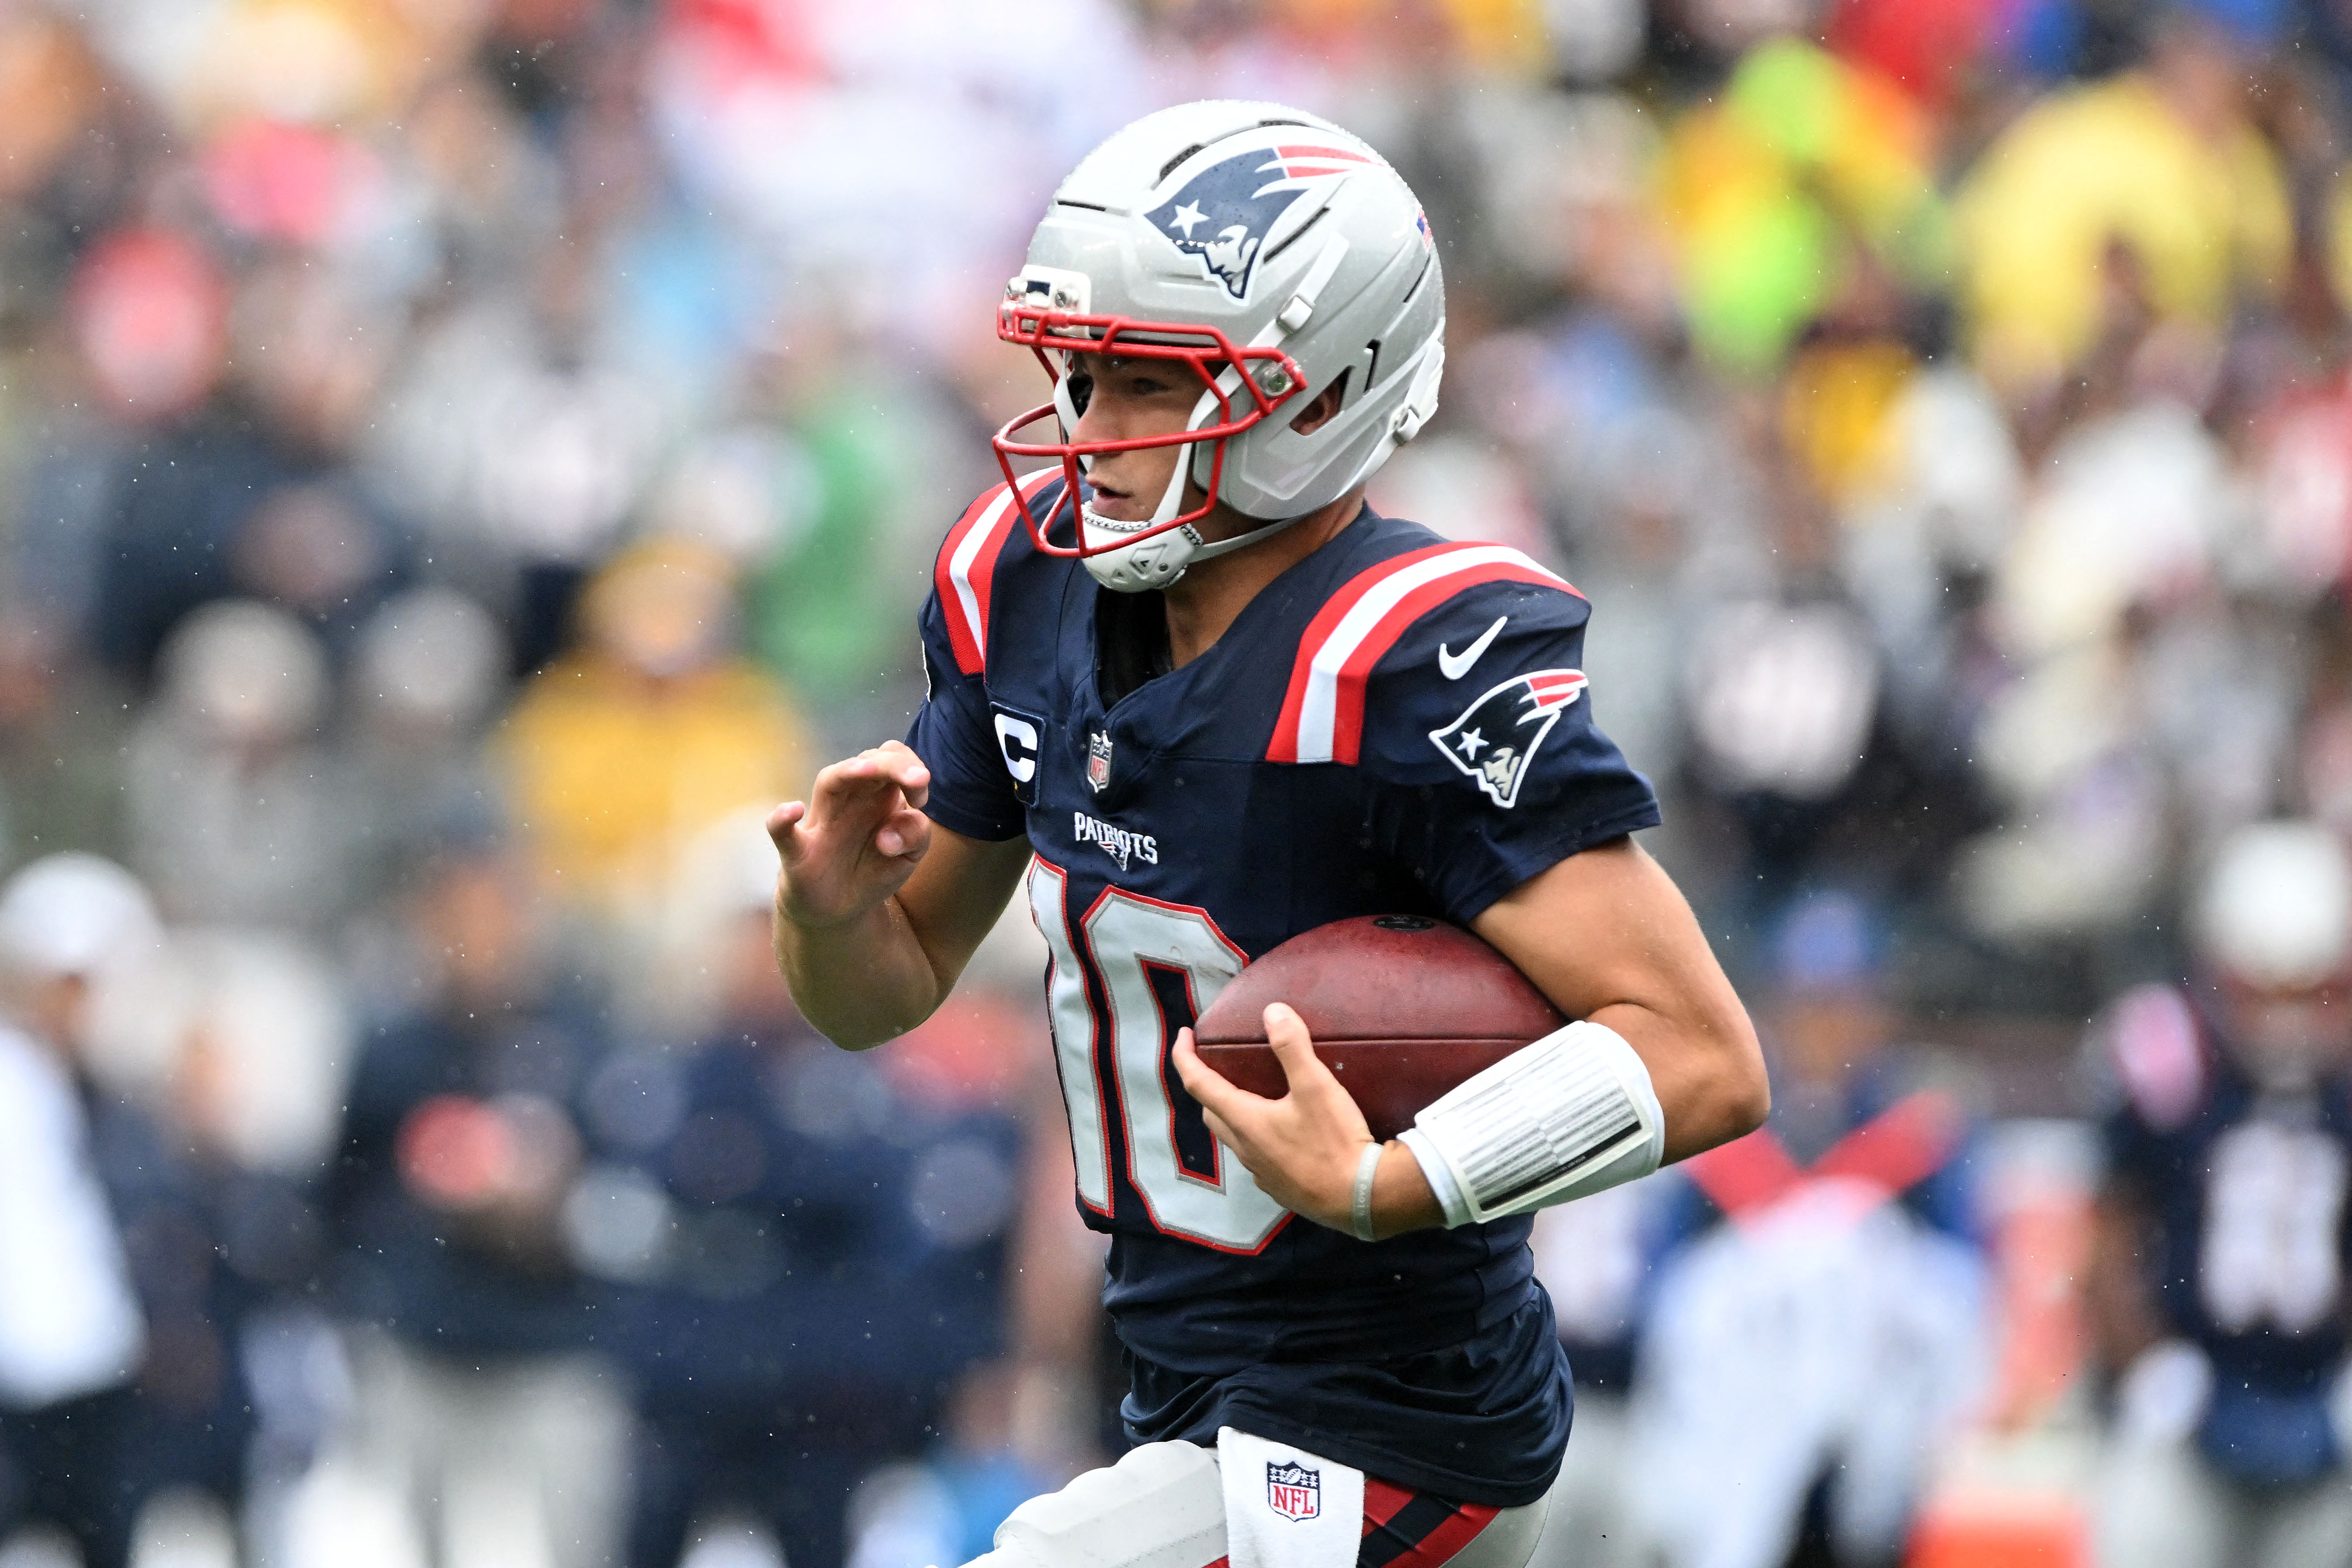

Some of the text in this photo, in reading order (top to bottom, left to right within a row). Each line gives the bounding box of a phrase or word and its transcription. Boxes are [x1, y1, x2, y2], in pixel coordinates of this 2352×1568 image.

[994, 713, 1038, 782] C
[1091, 757, 1106, 781] NFL
[1074, 811, 1158, 865] PATRIOTS
[1028, 852, 1295, 1255] 10
[1273, 1485, 1314, 1515] NFL
